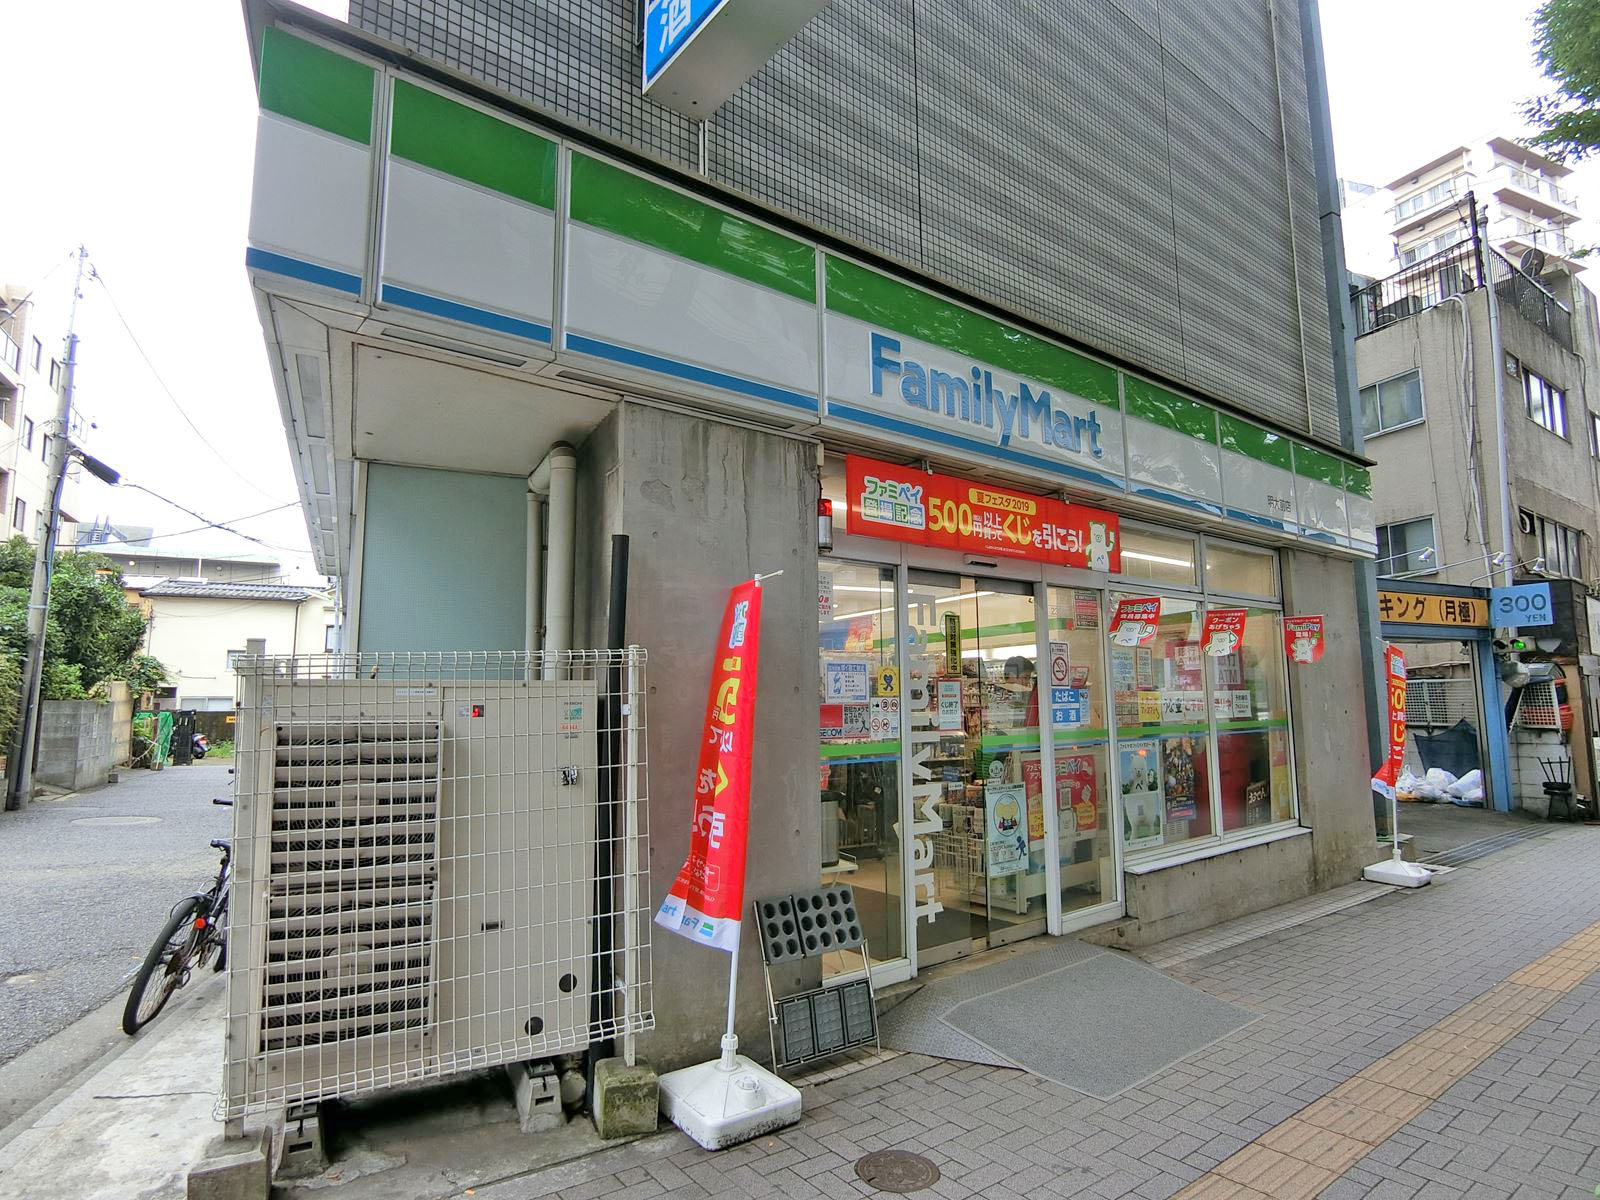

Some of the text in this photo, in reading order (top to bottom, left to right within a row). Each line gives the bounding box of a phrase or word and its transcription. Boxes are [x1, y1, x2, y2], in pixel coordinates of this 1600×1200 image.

[870, 331, 1103, 460] FamilyMart
[865, 478, 921, 504] ファミペイ
[928, 496, 972, 537] 500
[1380, 594, 1427, 619] キング
[1500, 593, 1547, 614] 300
[1525, 613, 1547, 624] YEN
[1055, 690, 1075, 702] たばこ
